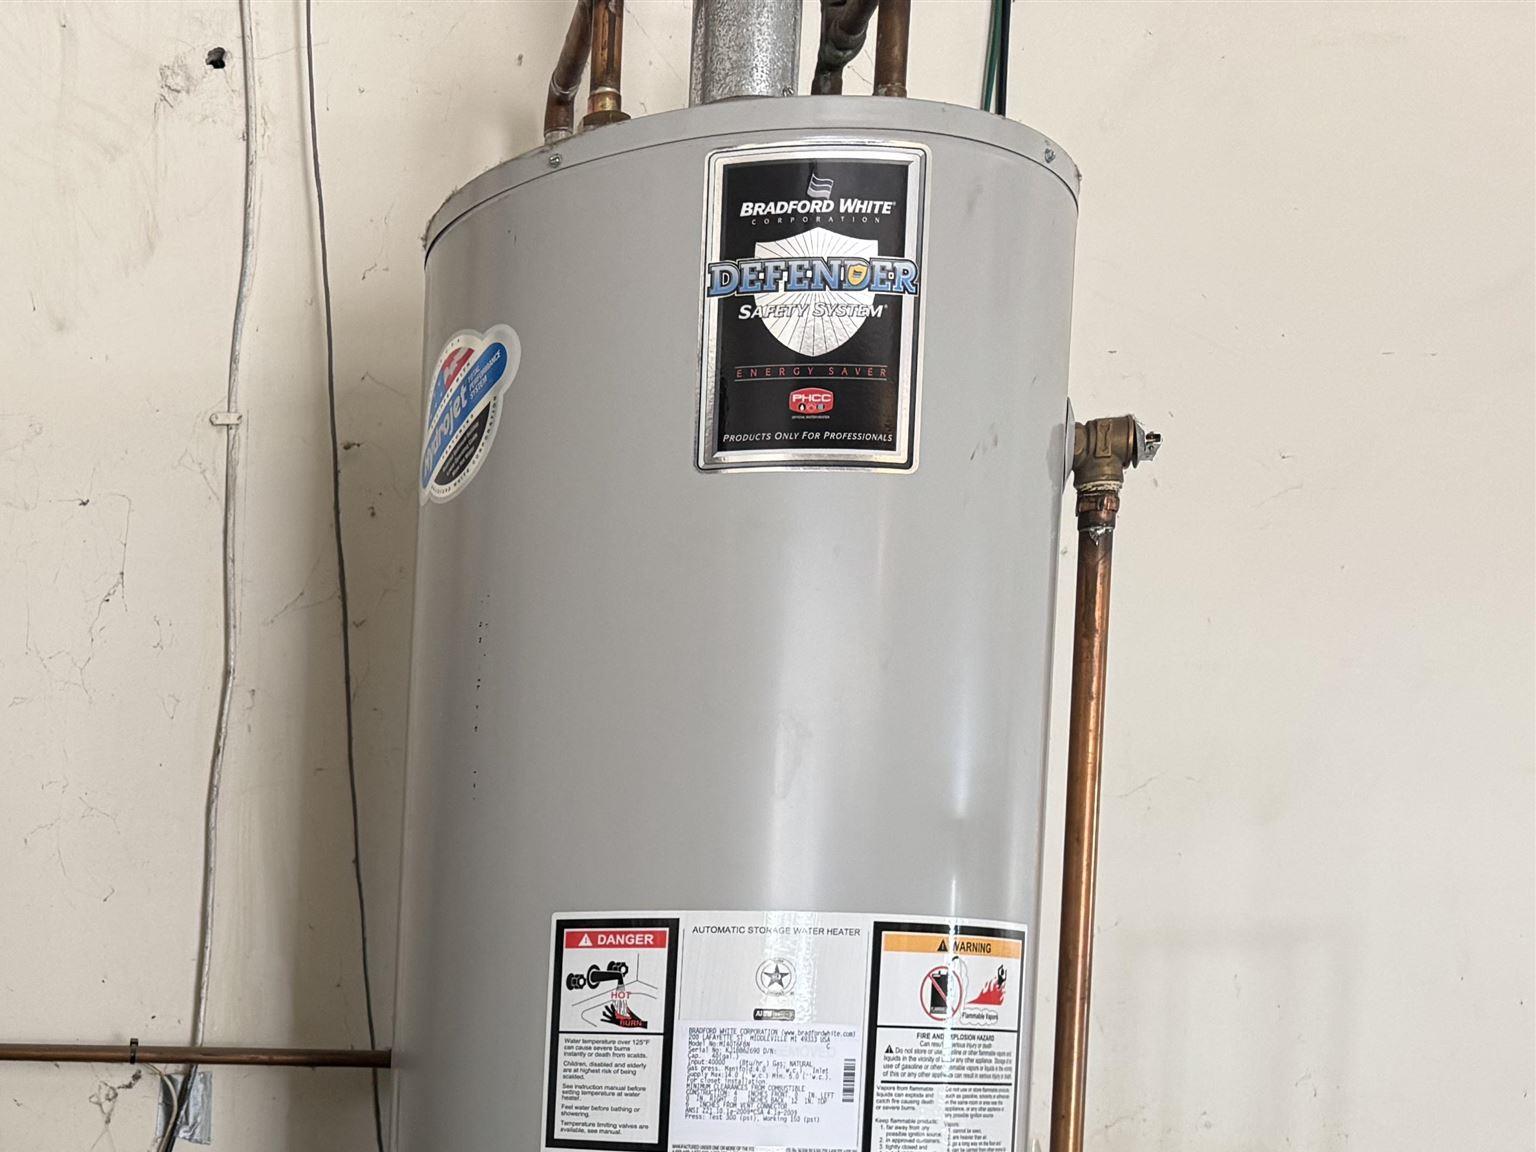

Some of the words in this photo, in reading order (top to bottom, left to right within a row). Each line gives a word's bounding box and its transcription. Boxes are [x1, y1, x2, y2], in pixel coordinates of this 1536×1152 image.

[739, 199, 835, 217] BRADFORD
[839, 198, 893, 215] WHITE
[751, 216, 881, 226] CORPORATION
[707, 256, 919, 298] DEFENDER
[738, 304, 810, 320] SAFETY
[812, 302, 884, 319] SYSTEM
[736, 367, 815, 378] ENERGY
[829, 367, 888, 377] SAVER
[792, 393, 832, 403] PHCC
[723, 433, 771, 443] PRODUCTS
[774, 431, 799, 441] ONLY
[801, 431, 820, 440] FOR
[823, 432, 893, 442] PROFESSIONALS
[692, 926, 746, 935] AUTOMATIC
[747, 926, 791, 935] STORAGE
[793, 927, 825, 936] WATER
[826, 928, 861, 936] HEATER
[597, 934, 654, 945] DANGER
[611, 991, 632, 1000] HOT
[619, 1019, 642, 1027] BURN
[627, 1062, 647, 1070] elderly
[610, 1106, 633, 1114] bathing
[560, 1120, 596, 1128] Temperature
